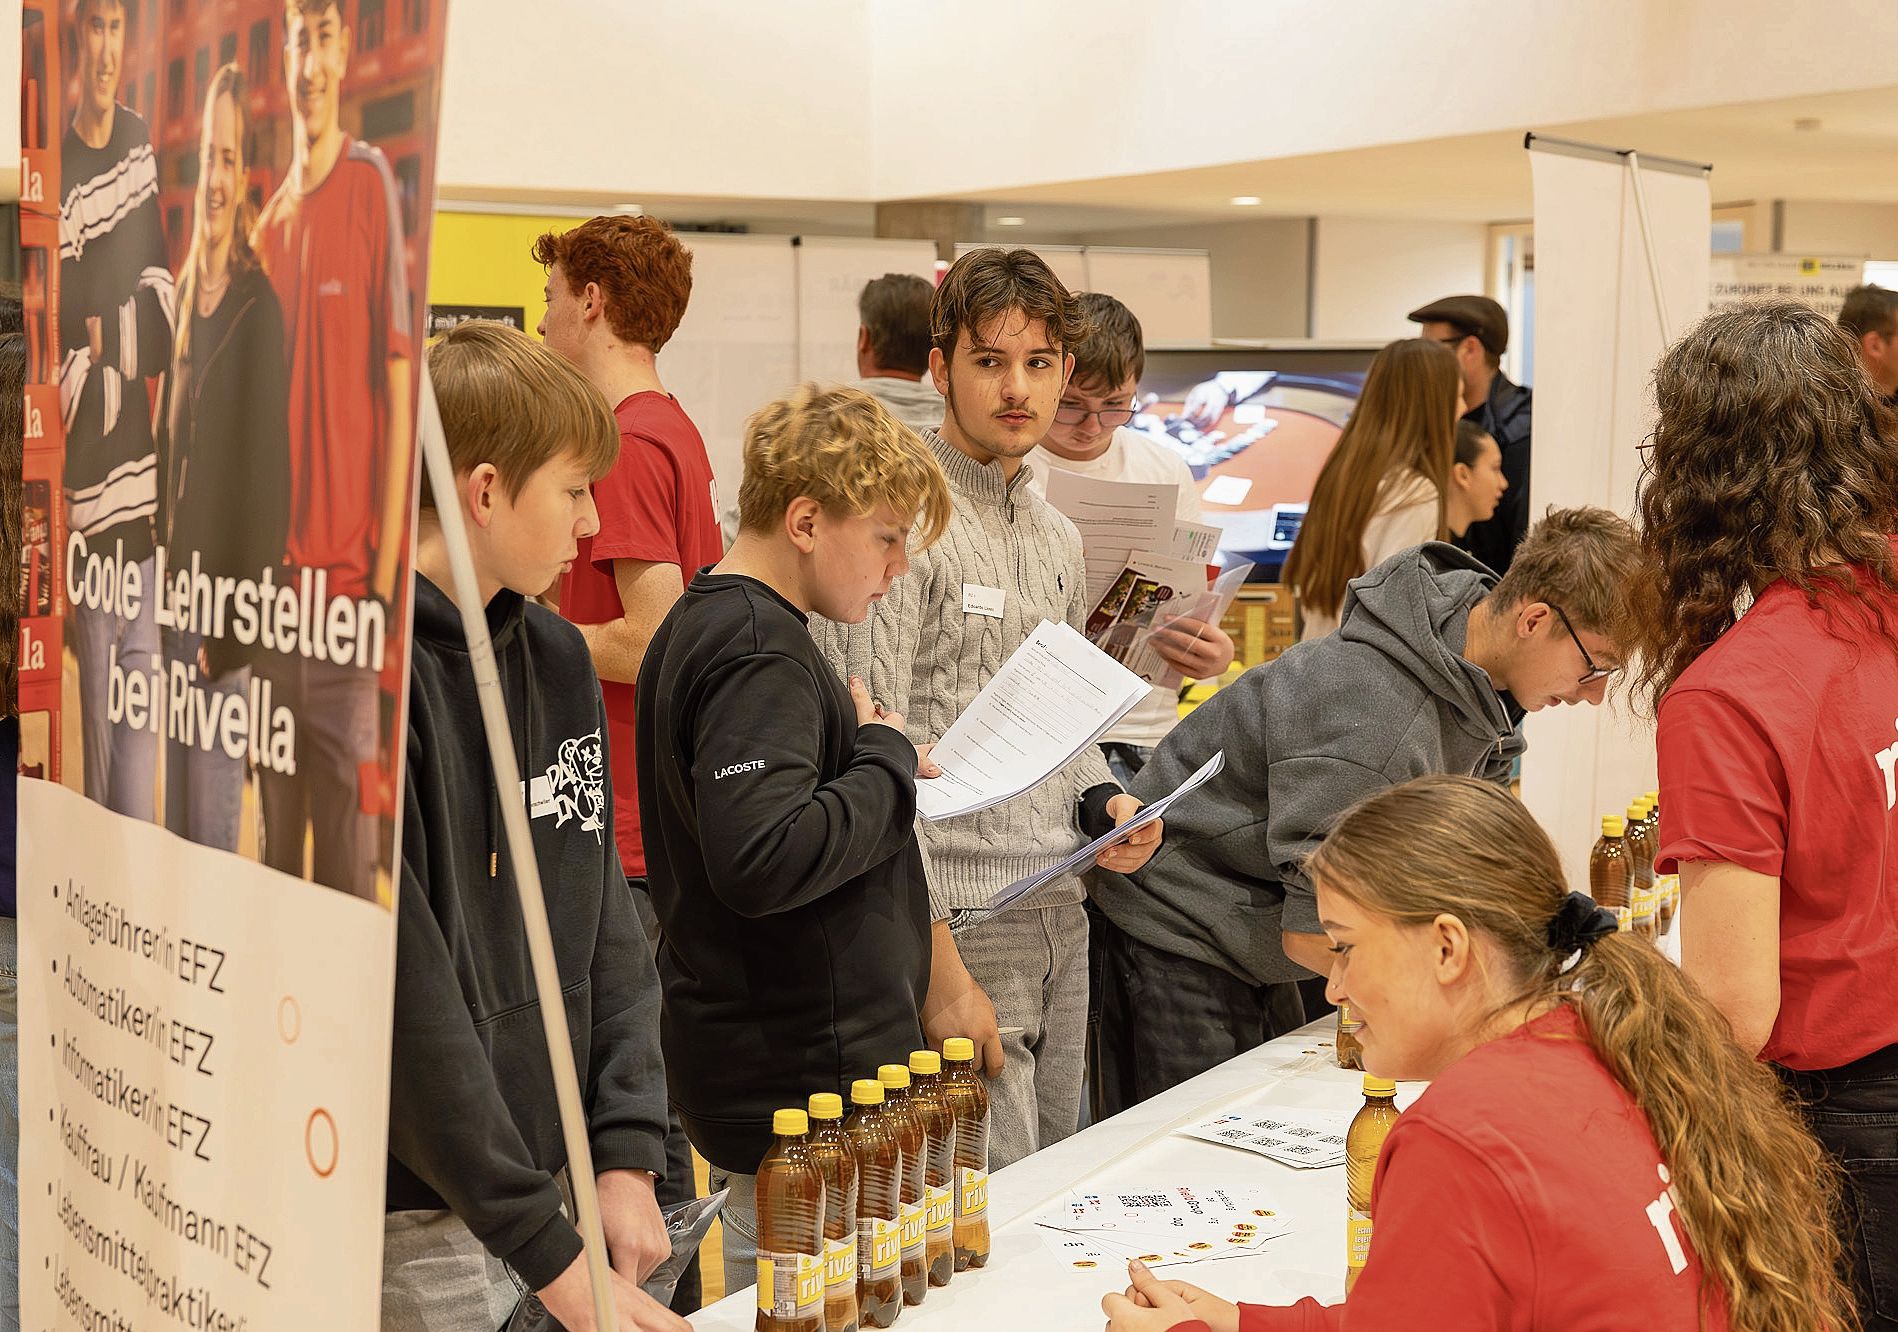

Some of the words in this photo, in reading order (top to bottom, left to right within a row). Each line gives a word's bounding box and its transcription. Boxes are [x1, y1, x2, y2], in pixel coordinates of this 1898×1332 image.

[66, 529, 143, 621] Coole
[154, 545, 386, 672] Lehrstellen
[108, 644, 160, 734] bei
[169, 660, 297, 776] Rivella
[714, 759, 766, 780] LACOSTE
[65, 878, 175, 975] Anlageführer/in
[178, 938, 225, 993] EFZ
[64, 953, 167, 1054] Automatiker/in
[170, 1019, 214, 1076] EFZ
[62, 1027, 165, 1138] Informatiker/in
[167, 1102, 211, 1161] EFZ
[60, 1103, 112, 1184] Kauffrau
[134, 1159, 229, 1259] Kaufmann
[234, 1223, 272, 1290] EFZ
